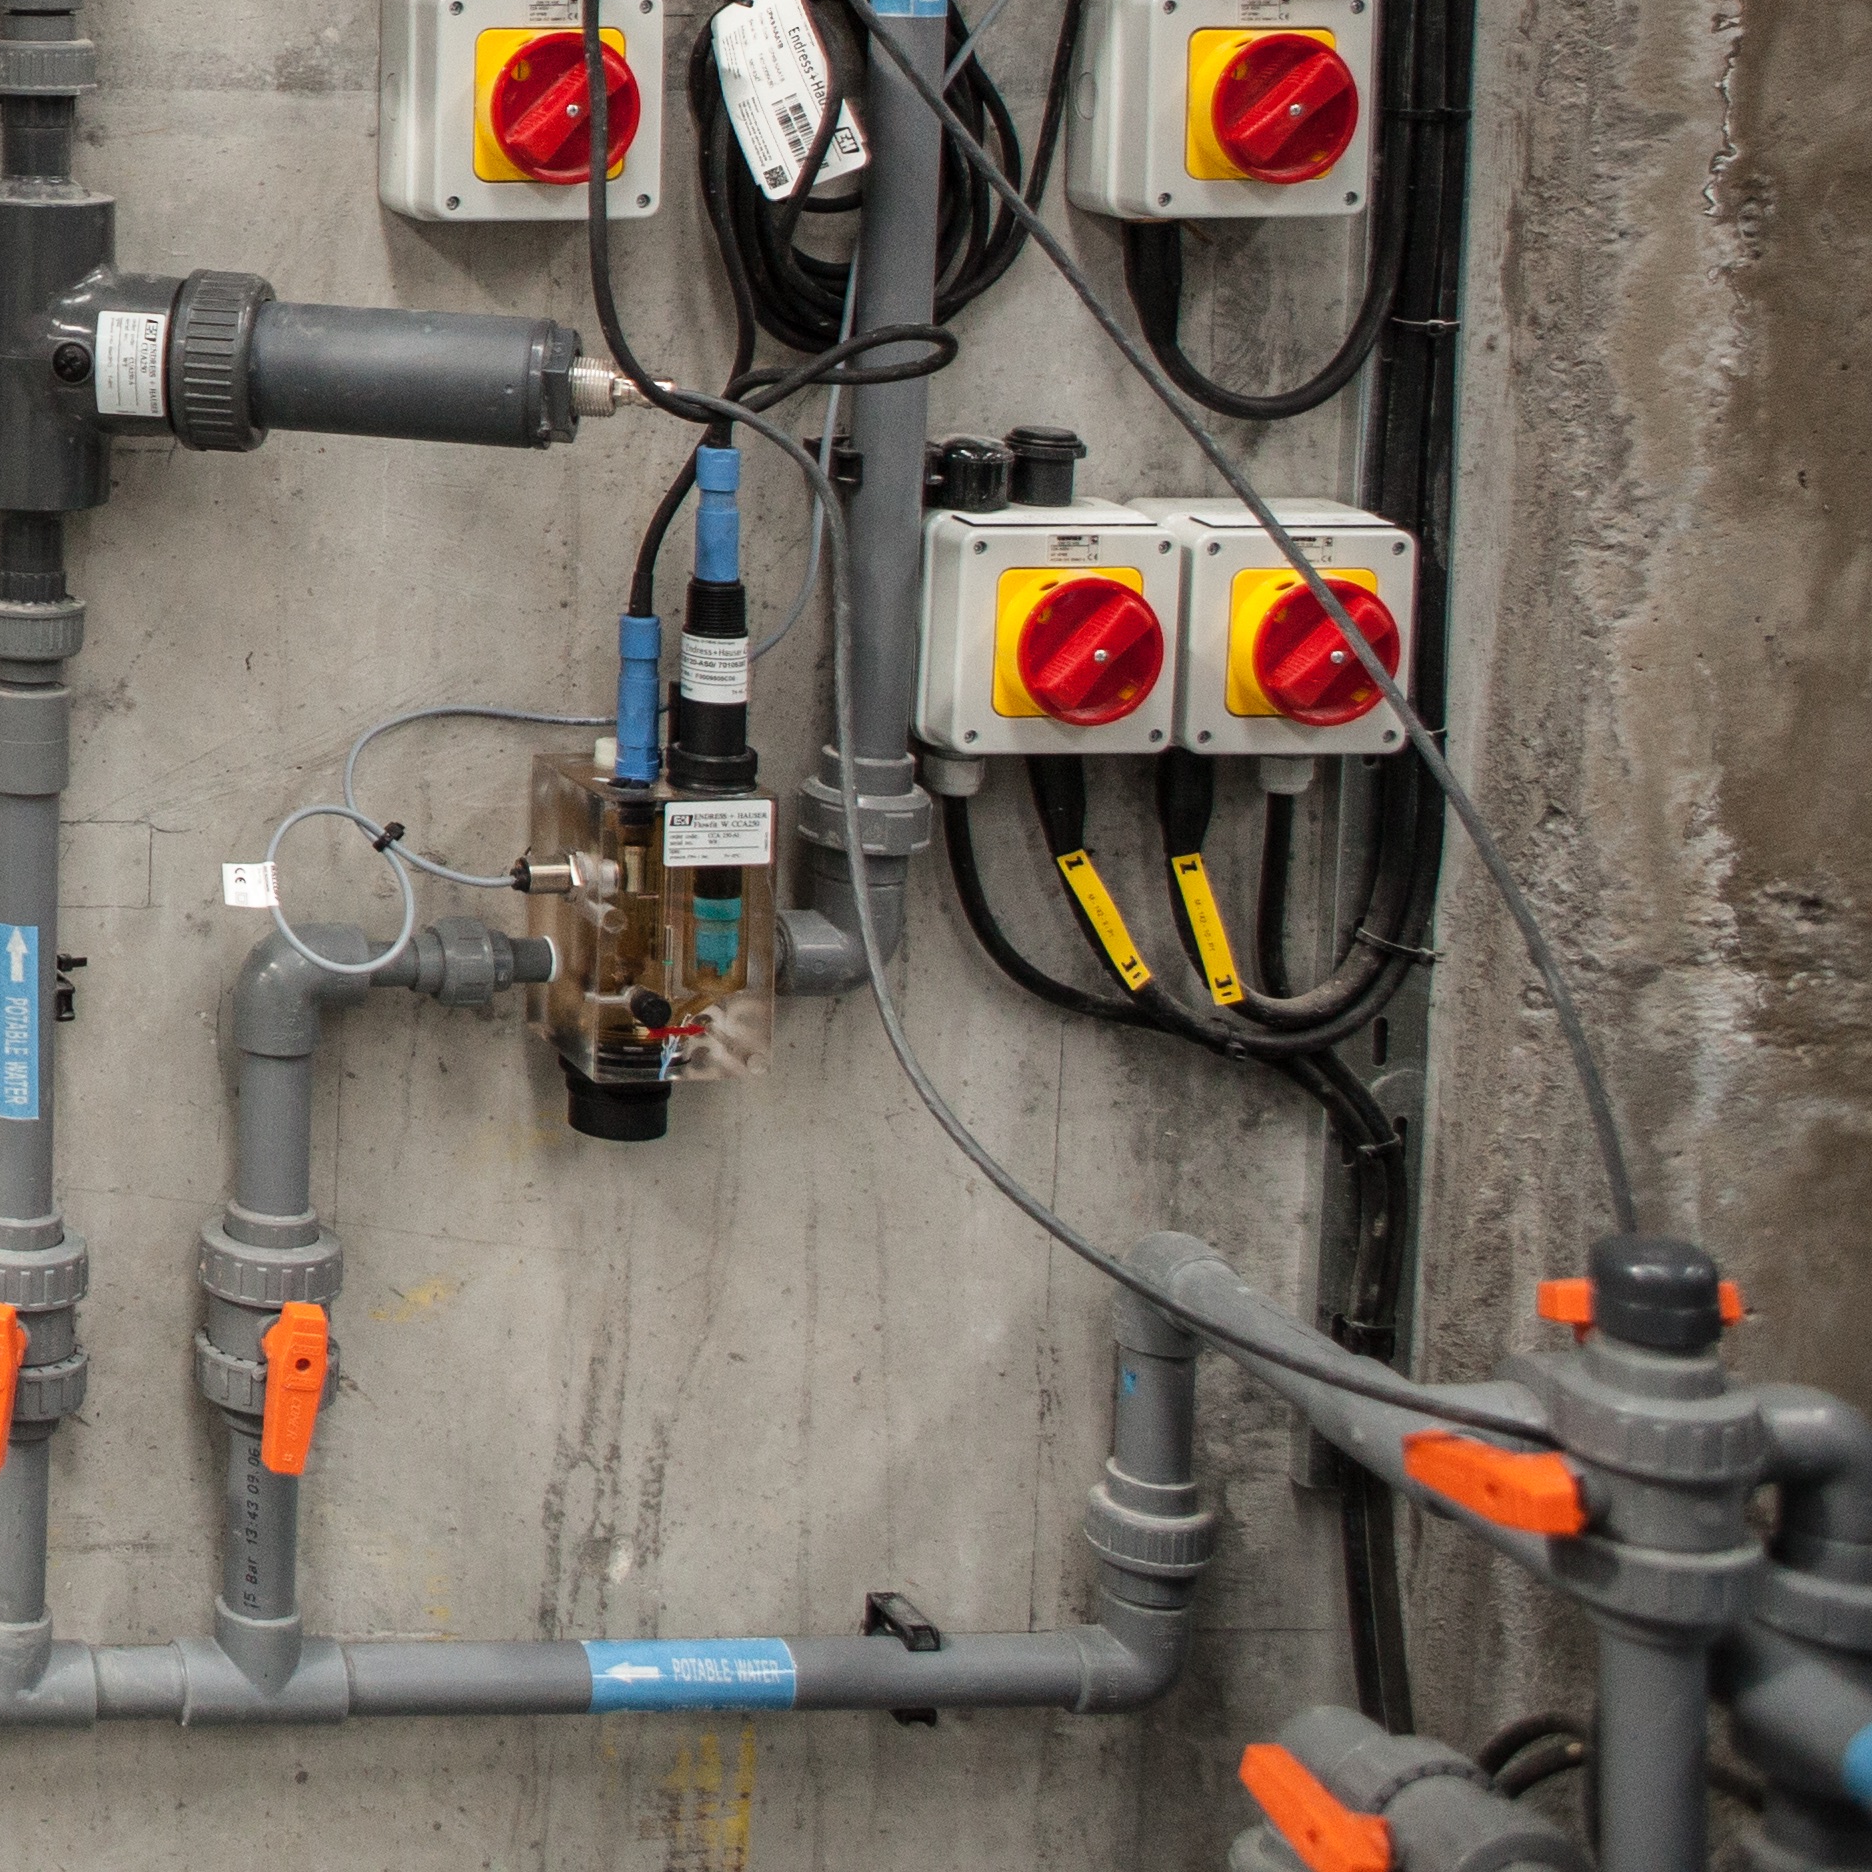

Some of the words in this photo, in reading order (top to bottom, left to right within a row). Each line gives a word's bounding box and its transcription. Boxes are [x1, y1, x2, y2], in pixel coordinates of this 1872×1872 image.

[4, 996, 29, 1056] POTABLE
[3, 1060, 28, 1106] WATER
[245, 1556, 258, 1585] Bar
[671, 1657, 732, 1683] POTABLE
[734, 1659, 780, 1684] WATER
